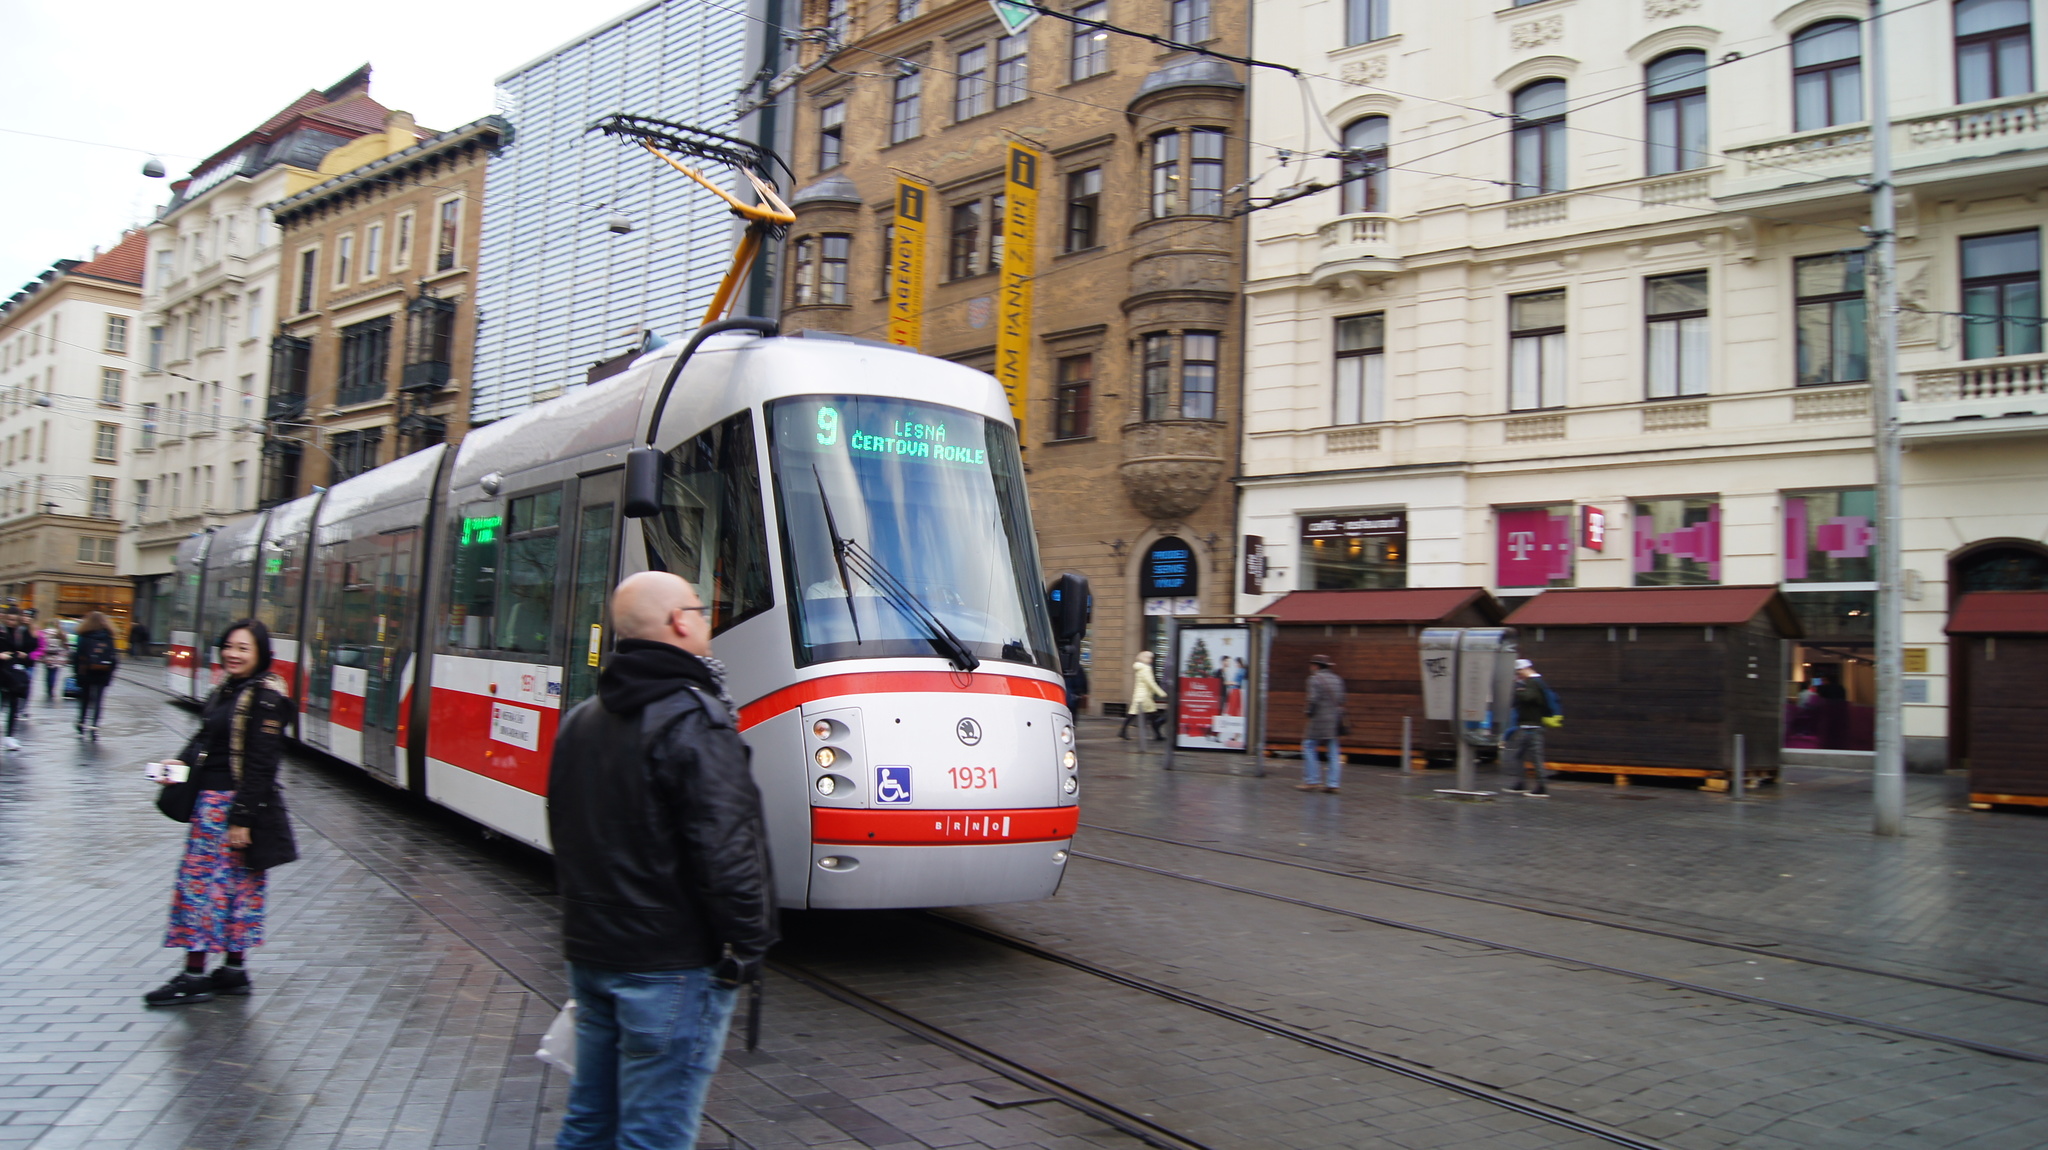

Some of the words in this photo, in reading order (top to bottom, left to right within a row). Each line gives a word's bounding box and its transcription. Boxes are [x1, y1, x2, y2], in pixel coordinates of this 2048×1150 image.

[896, 235, 913, 312] AGENCY
[816, 406, 839, 446] 9
[894, 418, 946, 443] LESNÁ
[851, 429, 929, 459] ČERTOVA
[933, 445, 985, 465] ROKLE
[947, 766, 999, 789] 1931
